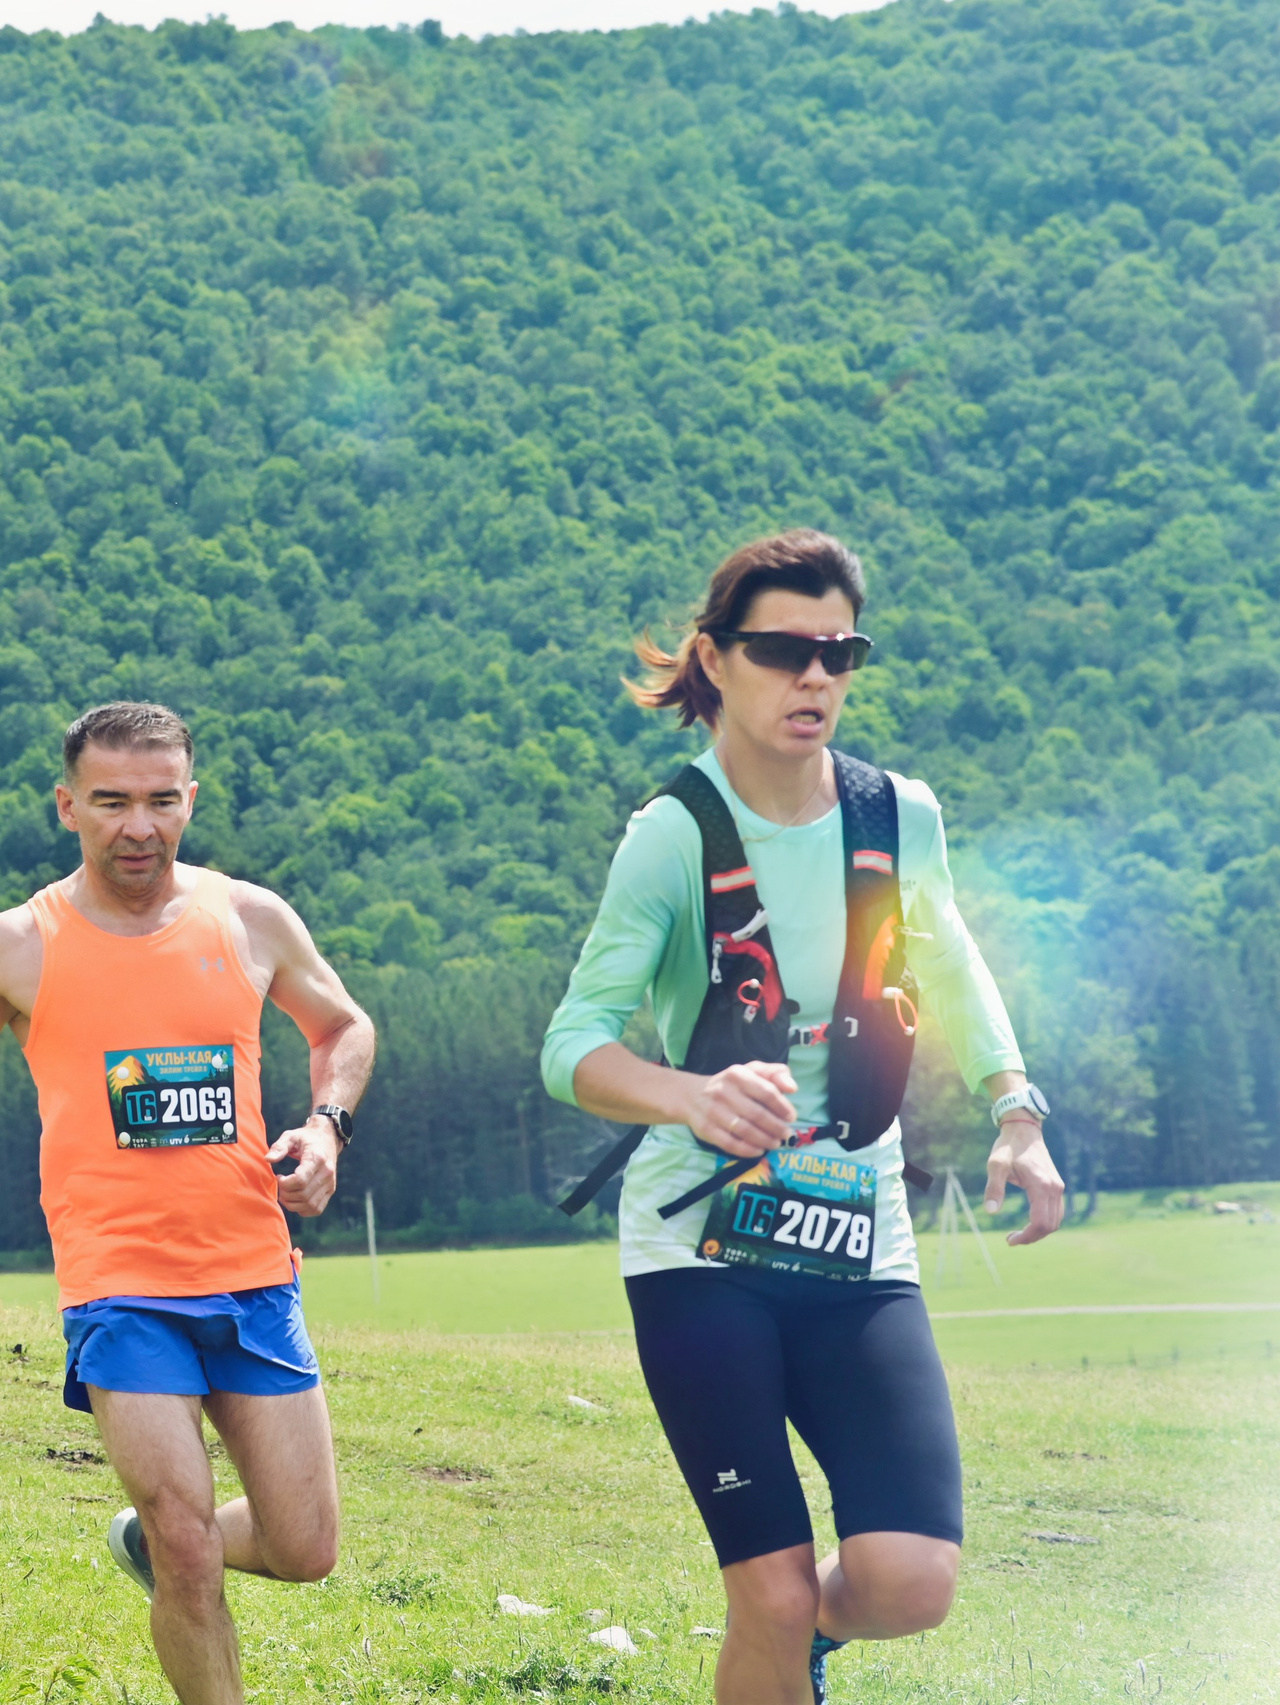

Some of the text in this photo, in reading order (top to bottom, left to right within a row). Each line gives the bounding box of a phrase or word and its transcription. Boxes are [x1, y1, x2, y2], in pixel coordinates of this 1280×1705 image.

[146, 1050, 212, 1067] УКЛЫ-КАЯ
[126, 1086, 232, 1123] 16 2063
[778, 1152, 857, 1182] УКЛЫ-КАЯ
[737, 1195, 871, 1259] 16 2078
[772, 1260, 790, 1271] UTV
